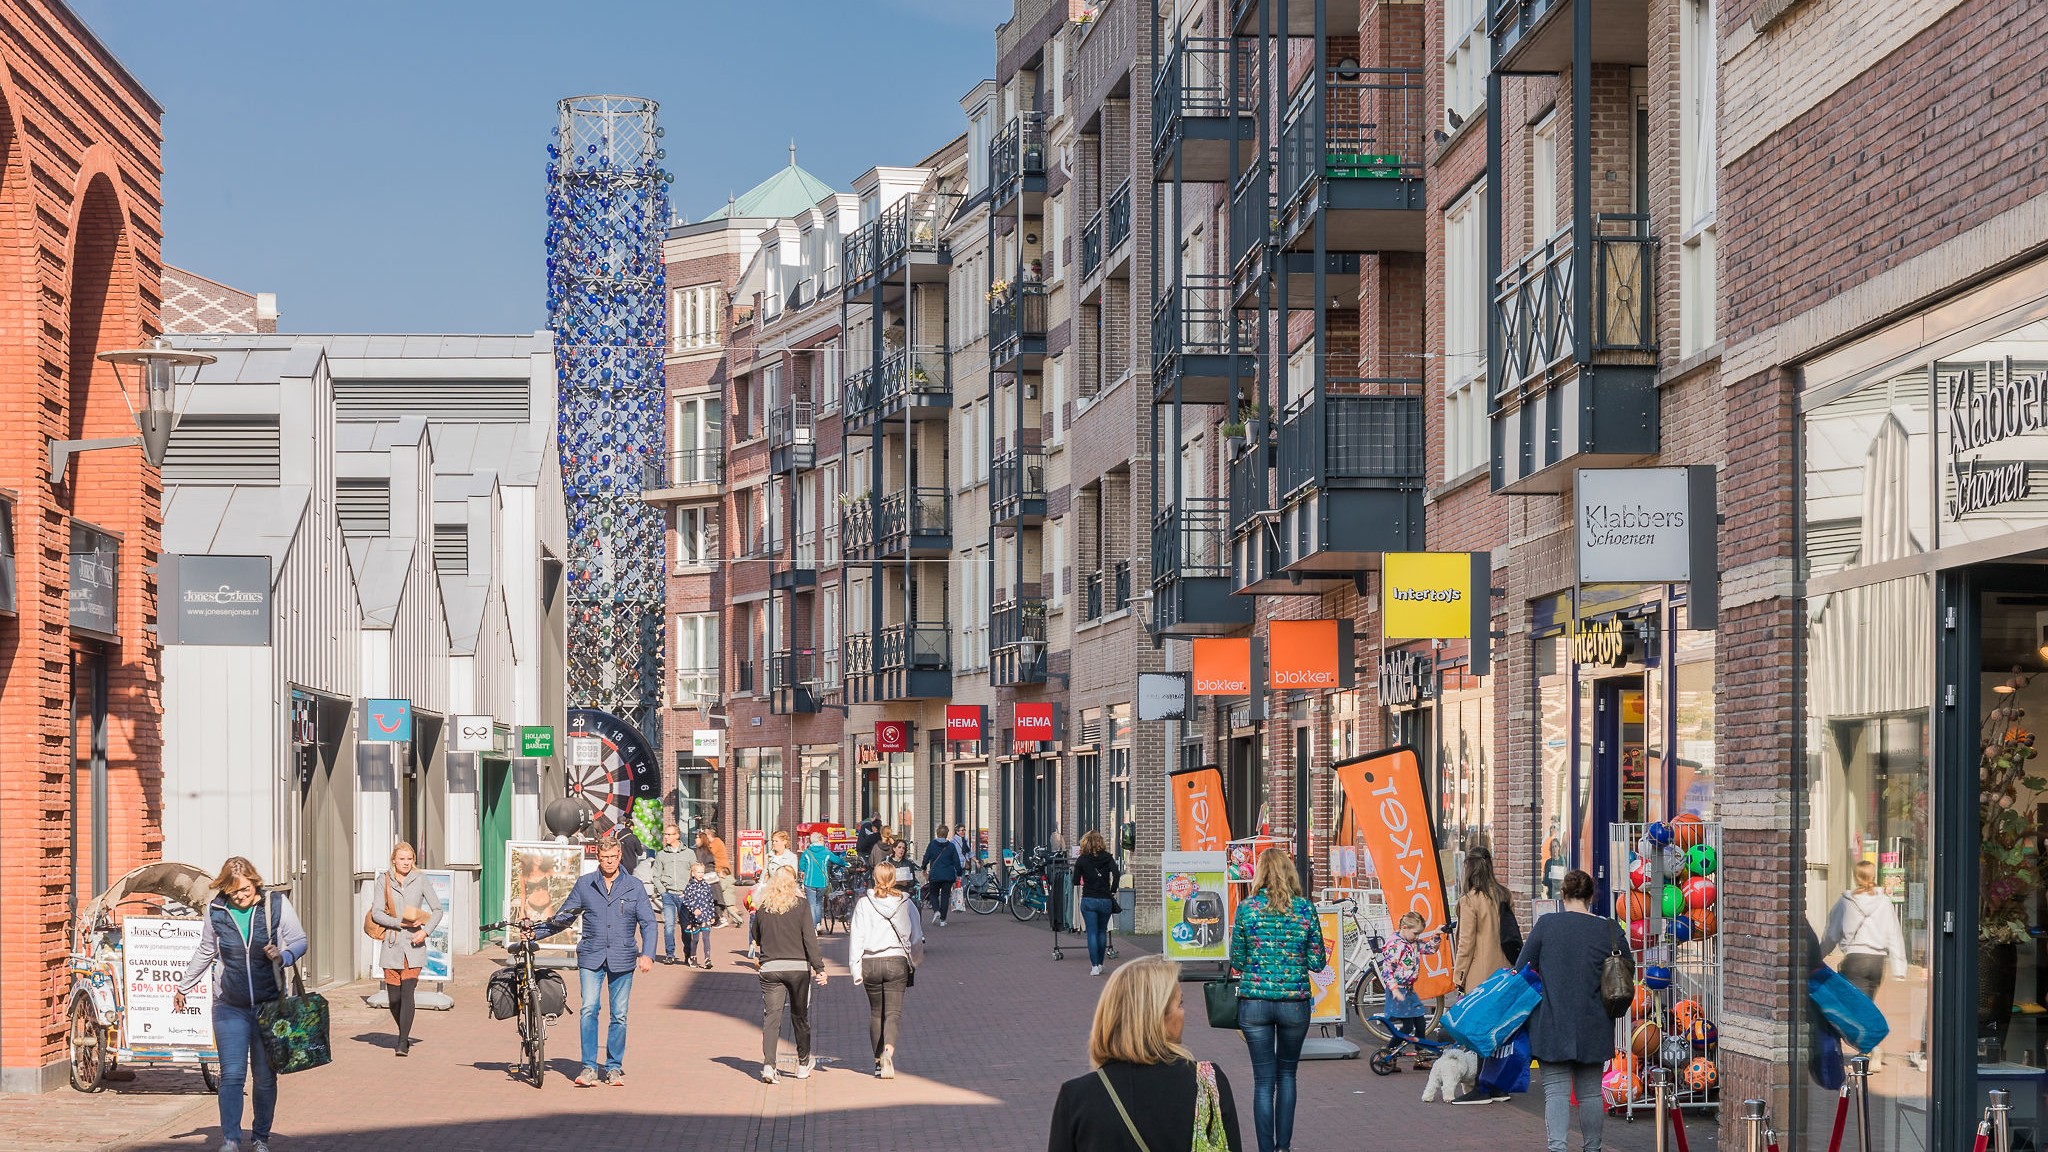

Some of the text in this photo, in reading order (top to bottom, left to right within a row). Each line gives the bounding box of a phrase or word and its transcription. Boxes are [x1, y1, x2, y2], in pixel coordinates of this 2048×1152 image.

[1949, 448, 2031, 522] Schoenen
[1586, 505, 1684, 528] Klabbers
[1587, 524, 1655, 547] Schoenen
[1392, 587, 1461, 603] Intertoys
[187, 608, 259, 616] www.jonesenjones.nl
[1571, 614, 1623, 668] Intertoys
[1275, 670, 1334, 684] blokker.
[1197, 680, 1247, 691] blokker.
[572, 718, 585, 727] 20
[947, 718, 979, 728] HEMA
[1017, 716, 1052, 727] HEMA
[611, 730, 624, 742] 18
[636, 762, 647, 774] 13
[129, 959, 168, 967] GLAMOUR
[152, 970, 186, 983] BRO
[131, 983, 208, 995] 50% KORNG
